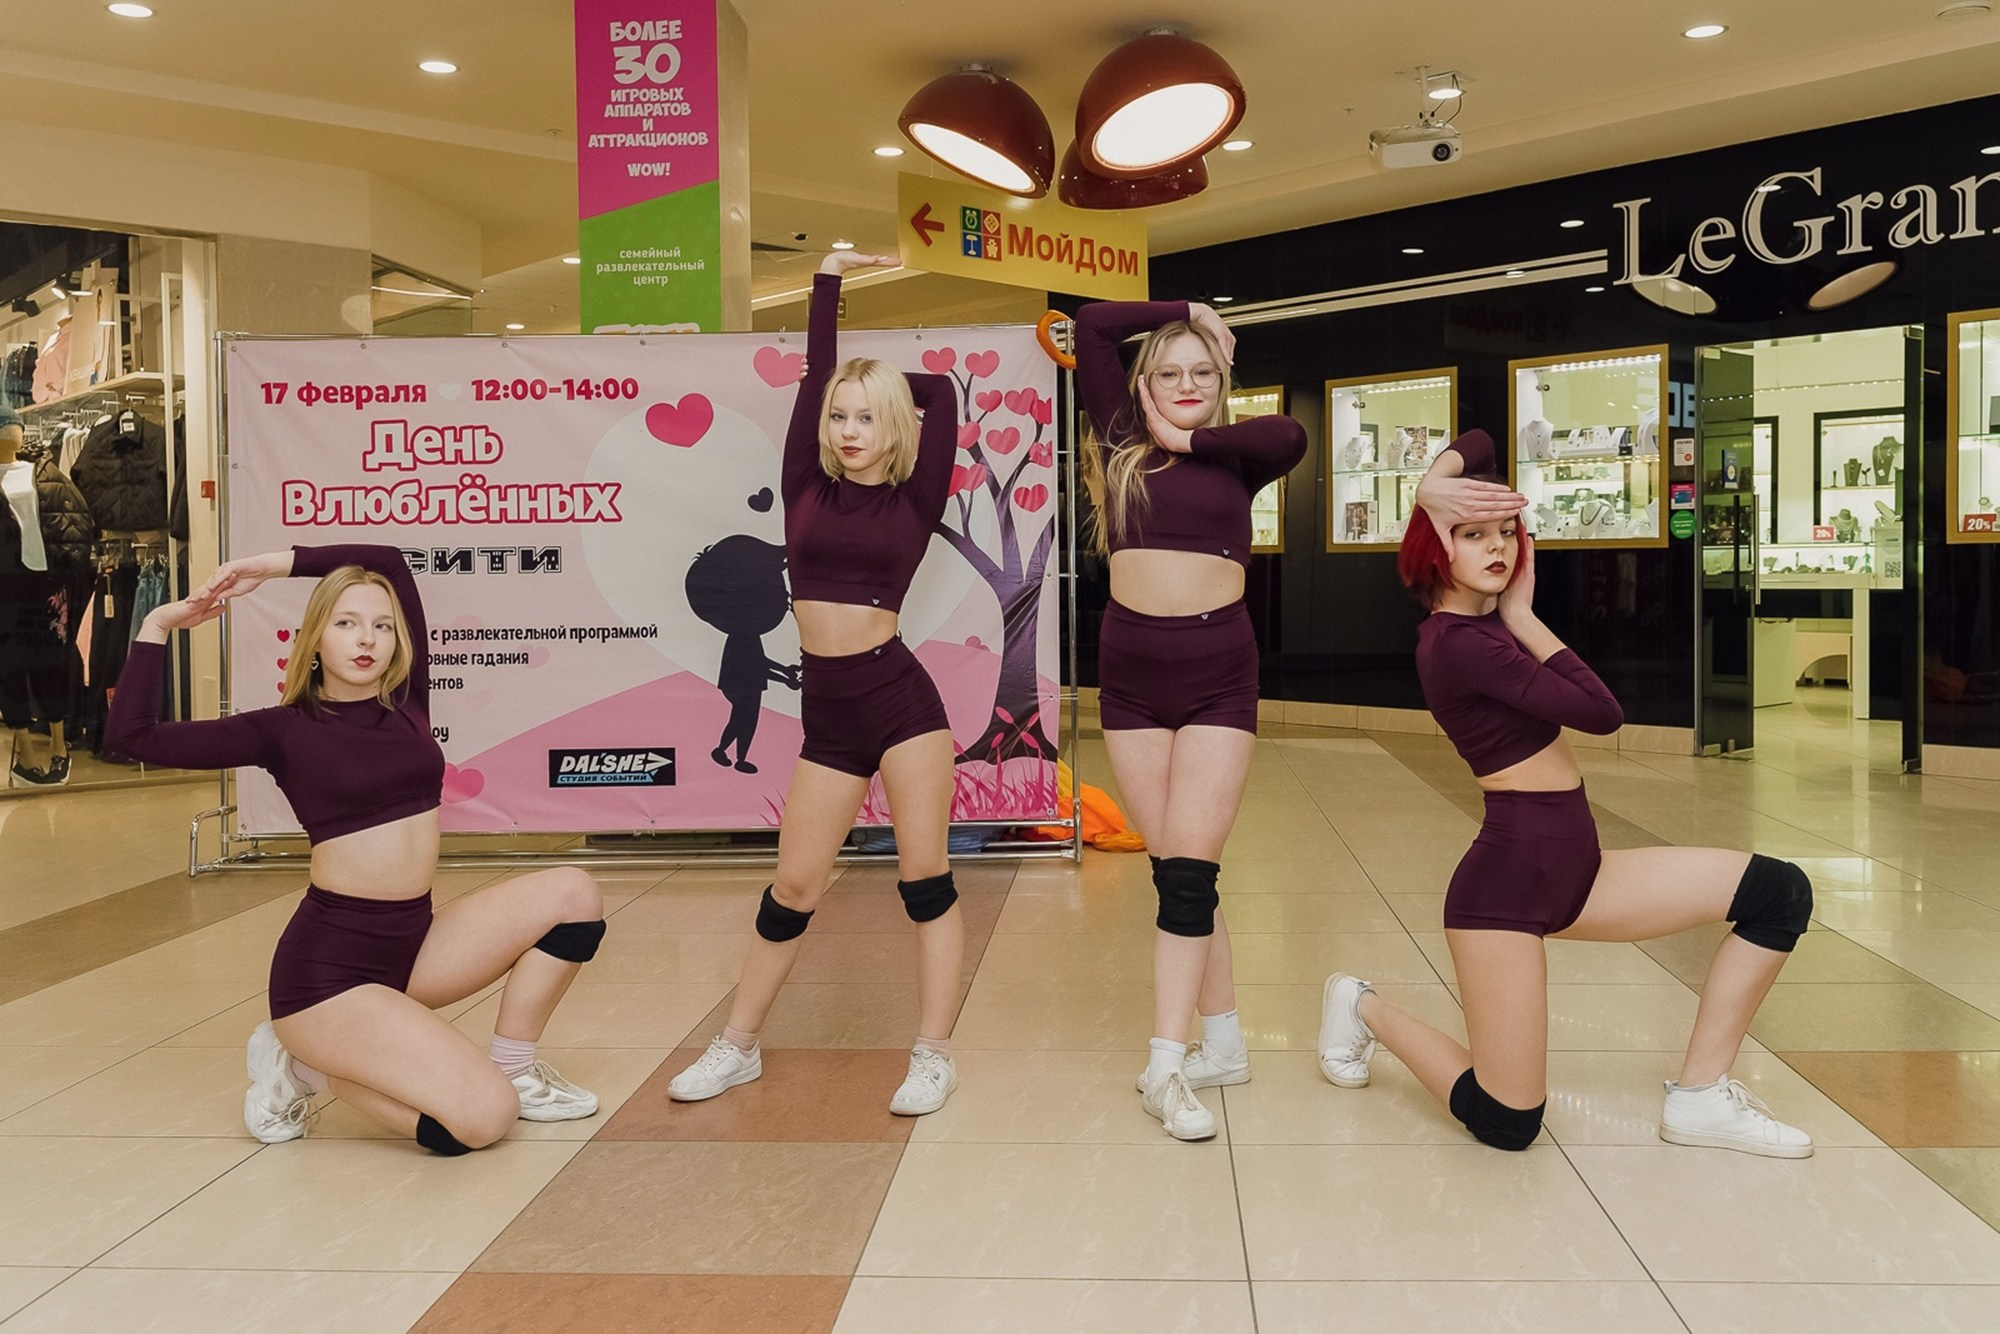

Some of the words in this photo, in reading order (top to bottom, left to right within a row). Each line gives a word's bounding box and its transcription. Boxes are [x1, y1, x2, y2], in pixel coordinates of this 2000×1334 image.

[609, 20, 683, 43] БОЛЕЕ
[613, 43, 682, 85] 30
[610, 87, 684, 103] ИГРОВЫХ
[604, 102, 692, 118] АППАРАТОВ
[642, 118, 654, 132] И
[588, 132, 709, 149] АТТРАКЦИОНОВ
[627, 162, 671, 177] WOW!
[619, 247, 681, 259] семейный
[1007, 223, 1139, 277] МойДом
[596, 259, 705, 275] развлекательный
[633, 274, 669, 287] центр
[260, 381, 288, 405] 17
[296, 380, 427, 410] февраля
[471, 377, 640, 402] 12:00-14:00
[362, 419, 504, 472] День
[282, 473, 623, 526] Влюблённых
[1967, 518, 1991, 531] 20%
[442, 624, 567, 646] развлекательной
[570, 624, 659, 643] программой
[427, 653, 468, 666] овные
[471, 651, 530, 667] гадания
[432, 725, 450, 742] оу
[560, 775, 598, 783] СТУДИЯ
